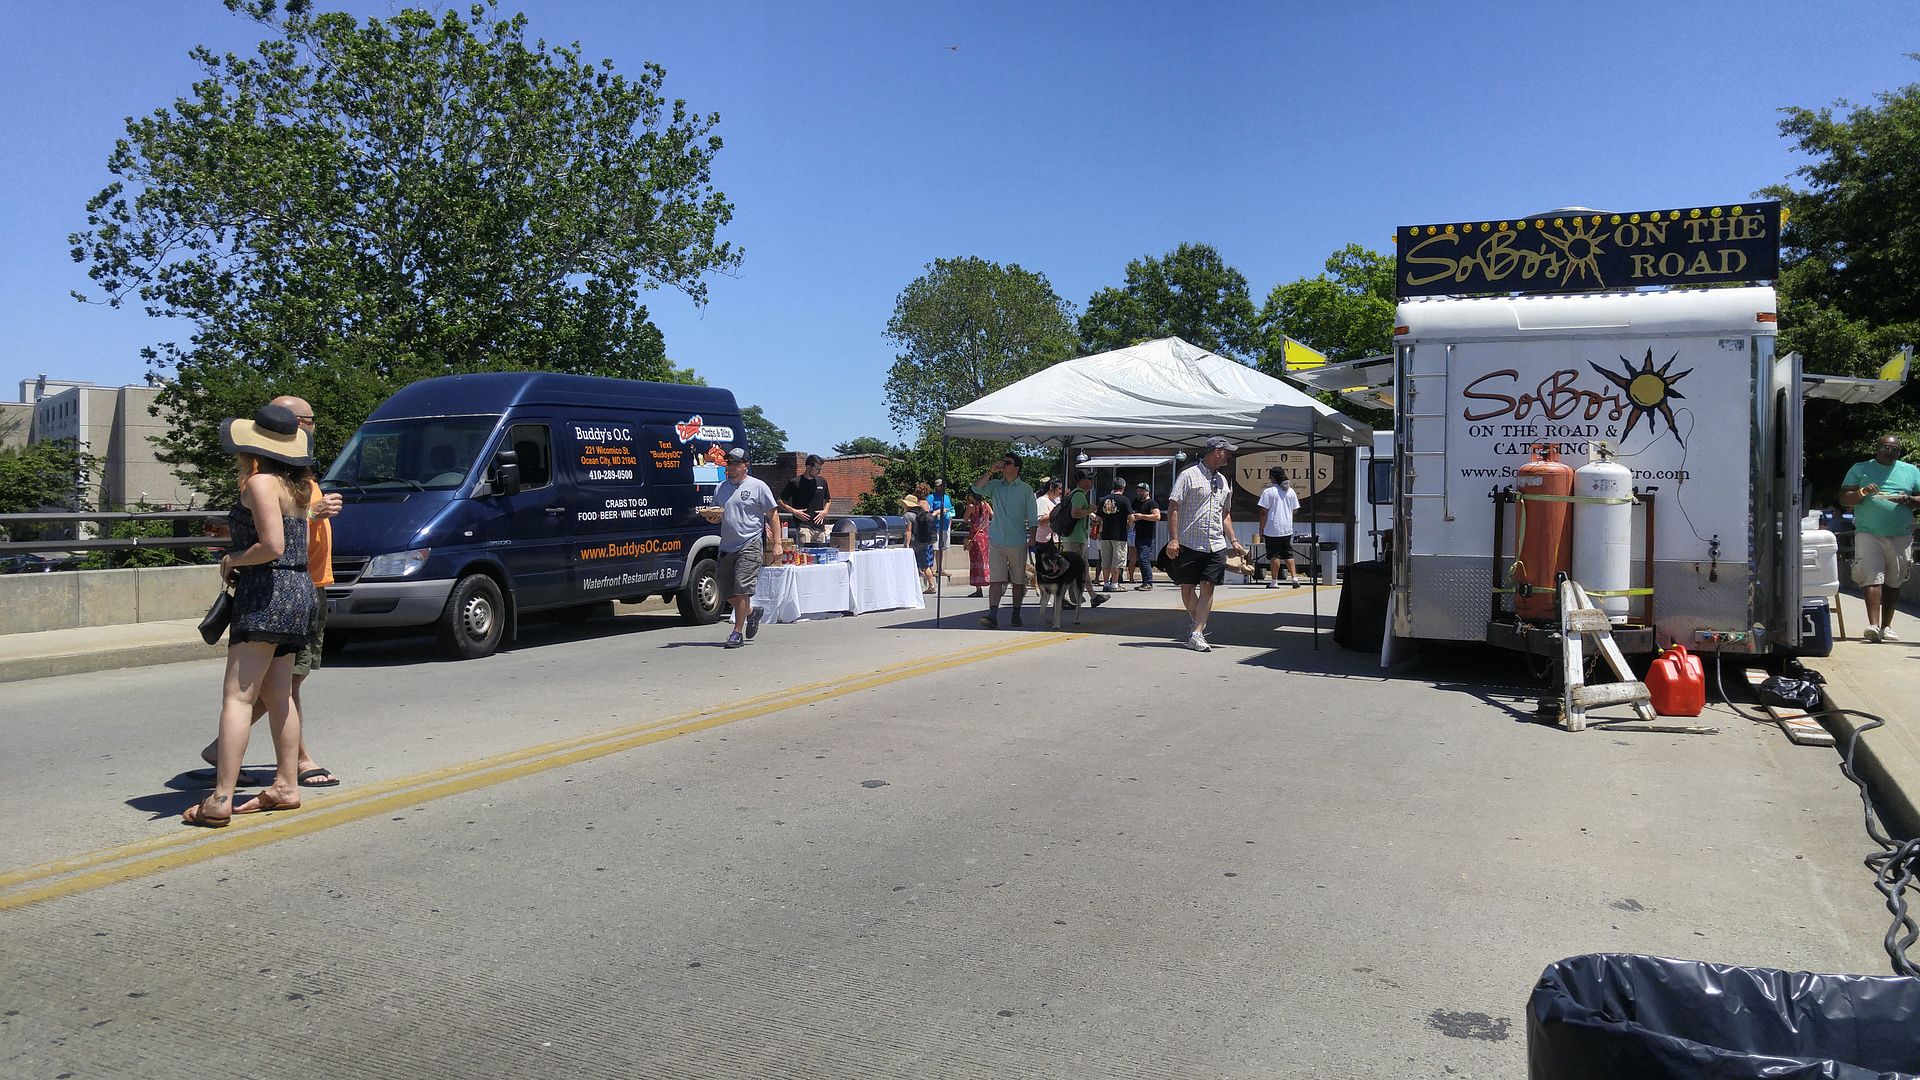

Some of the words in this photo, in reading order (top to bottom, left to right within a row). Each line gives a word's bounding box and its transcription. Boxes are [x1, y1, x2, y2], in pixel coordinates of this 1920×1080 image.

[1406, 229, 1567, 286] SoBo's
[1613, 221, 1671, 248] ON
[1683, 214, 1767, 244] THE
[1630, 249, 1748, 278] ROAD
[1463, 369, 1631, 421] SoBo's
[575, 427, 613, 443] Buddy's
[613, 428, 633, 441] O.C.
[1468, 424, 1498, 438] ON
[1501, 425, 1538, 437] THE
[1545, 425, 1599, 437] ROAD
[1605, 424, 1618, 438] &
[585, 445, 596, 455] 221
[596, 446, 622, 455] Wicomico
[658, 440, 672, 449] Text
[1493, 442, 1589, 455] CATING
[581, 456, 599, 465] Ocean
[612, 457, 621, 465] MD
[589, 469, 633, 480] 410-289-0500
[605, 499, 628, 508] CRABS
[628, 498, 637, 508] TO
[638, 498, 648, 507] GO
[578, 511, 598, 521] FOOD
[600, 510, 618, 520] BEER
[620, 509, 637, 519] WINE
[639, 508, 659, 518] CARRY
[660, 507, 673, 516] OUT
[581, 540, 681, 560] www.BuddysOC.com
[583, 573, 621, 591] Waterfront
[622, 569, 659, 585] Restaurant
[660, 568, 665, 580] &
[666, 567, 679, 579] Bar
